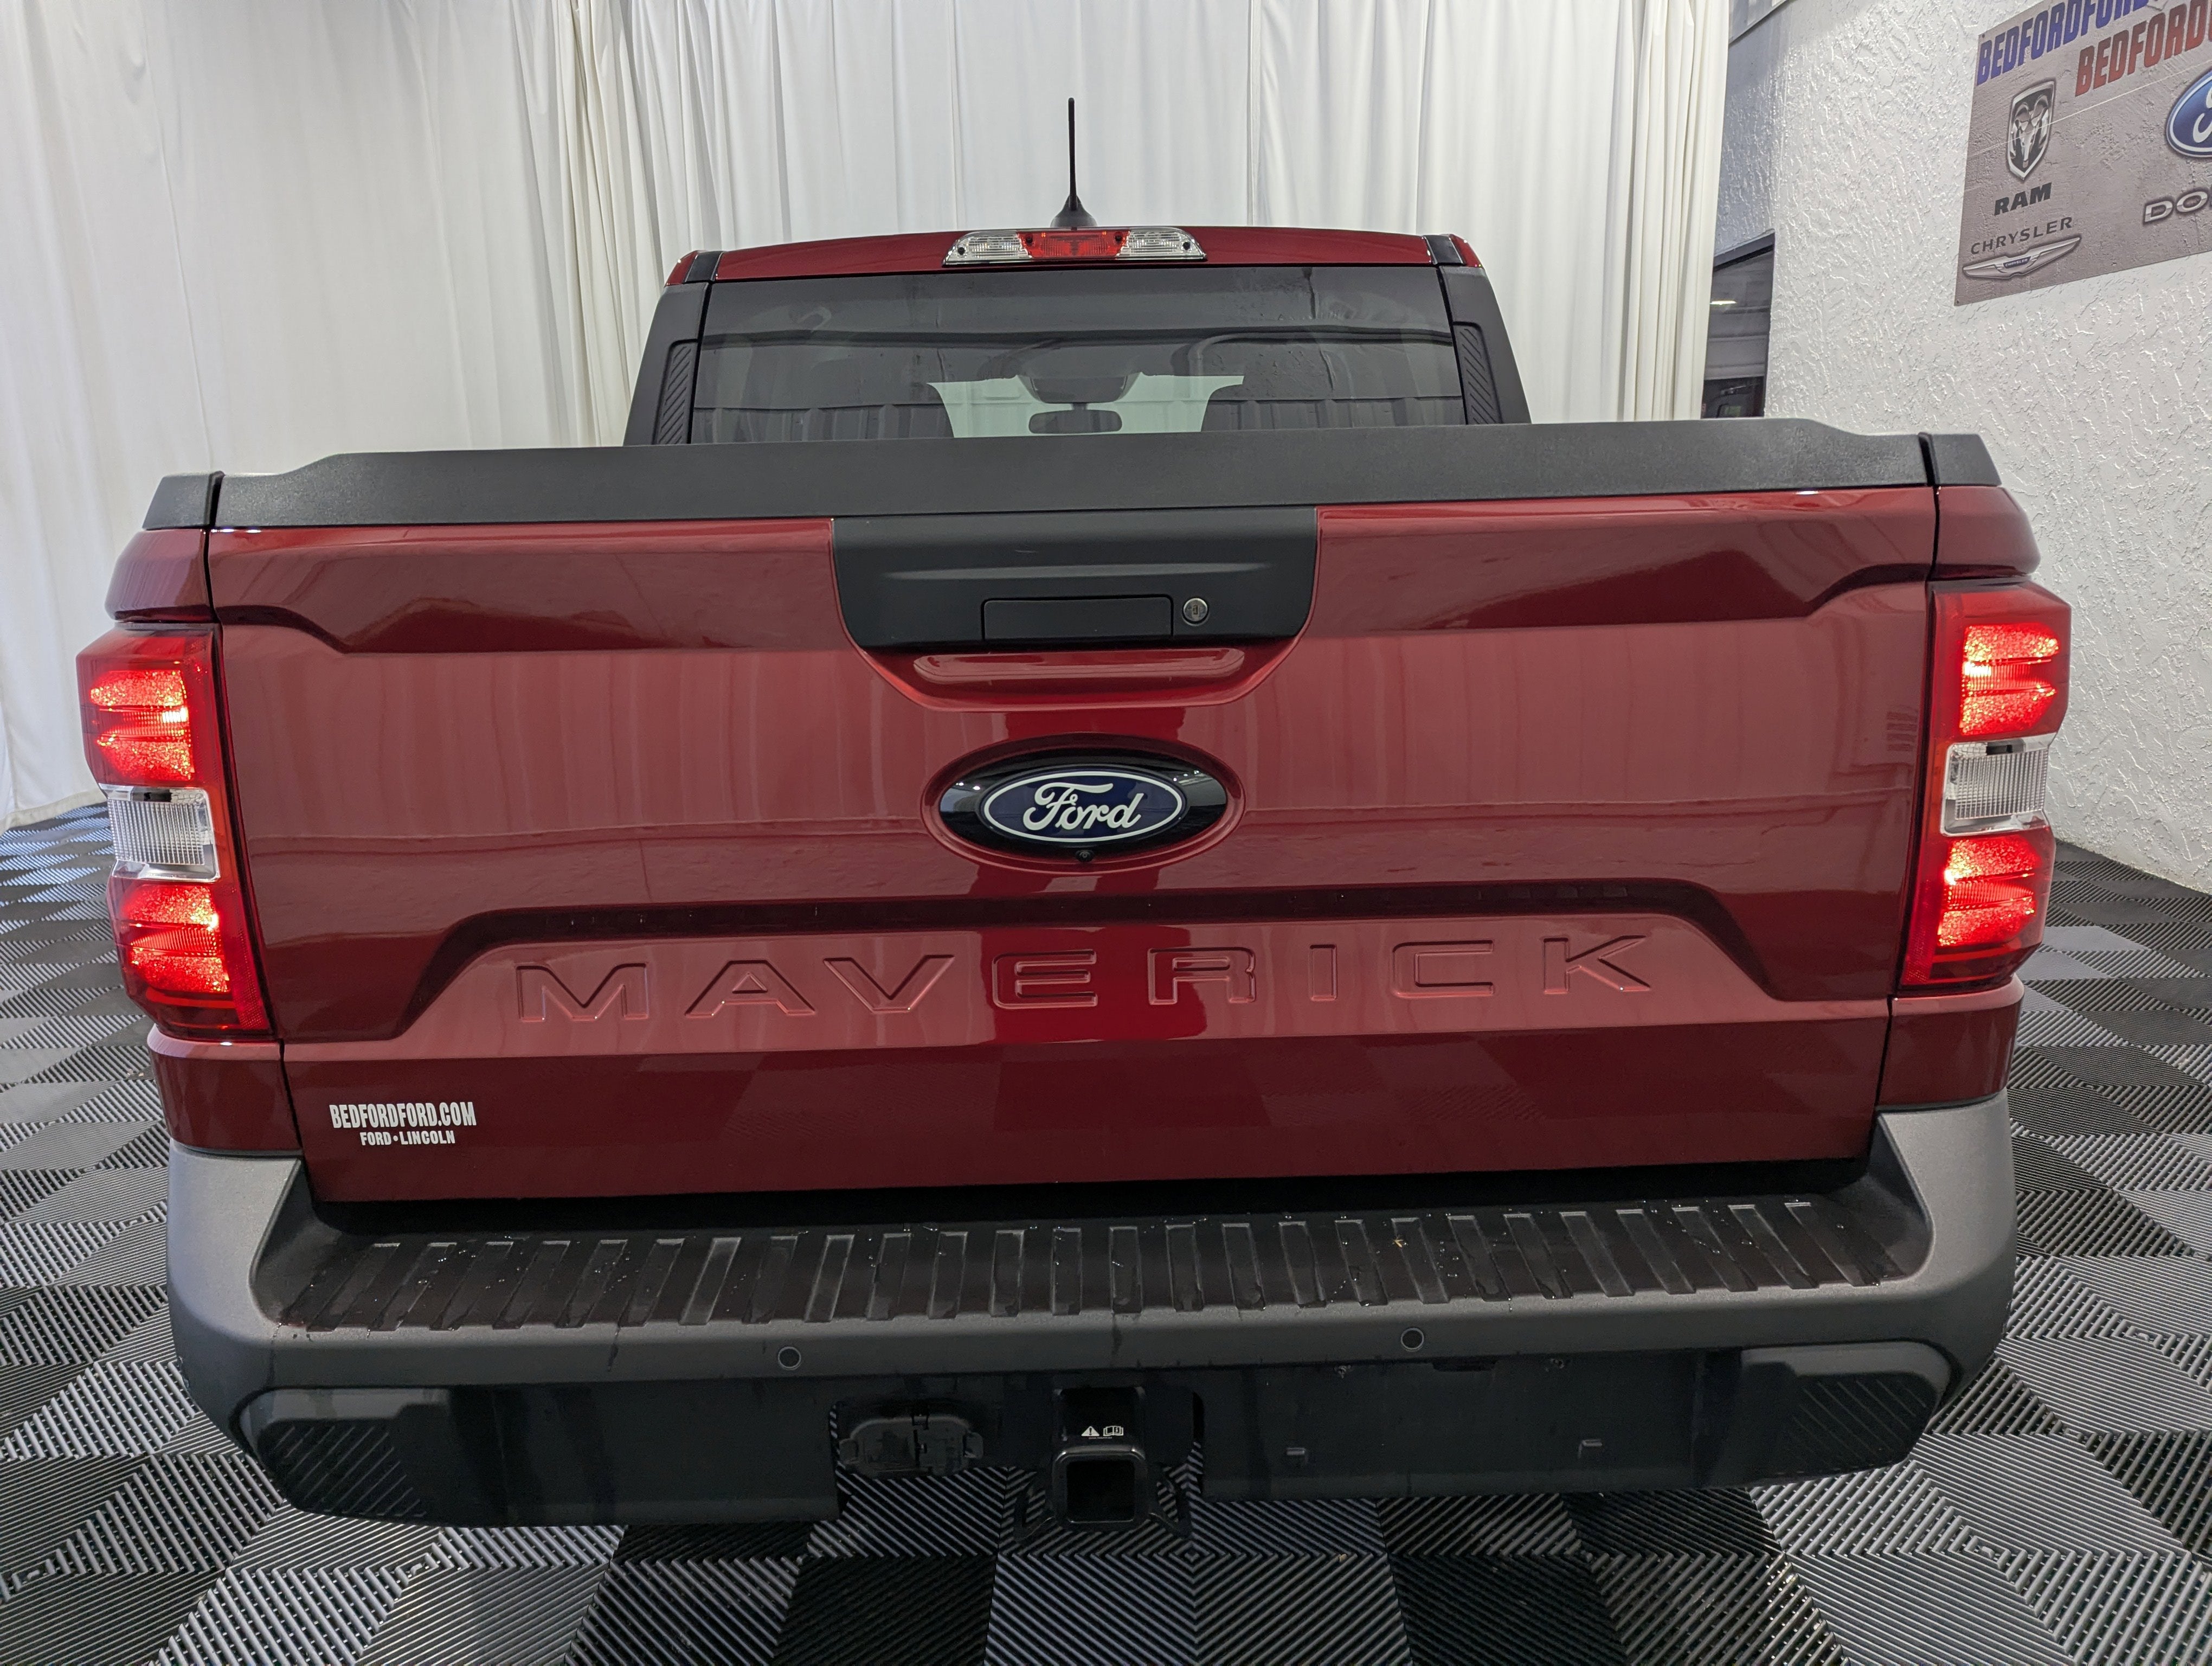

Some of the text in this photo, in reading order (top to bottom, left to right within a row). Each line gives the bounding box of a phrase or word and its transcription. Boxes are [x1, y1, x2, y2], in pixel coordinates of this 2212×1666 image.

[1977, 0, 2149, 86] BEDFORDFO
[2075, 0, 2212, 97] BEDFORD
[1994, 182, 2052, 216] RAM
[1971, 217, 2072, 254] CHRYSLER
[1023, 782, 1144, 831] Ford
[516, 935, 1651, 1022] MAVERICK
[329, 1102, 477, 1128] BEDFORDFORD.COM
